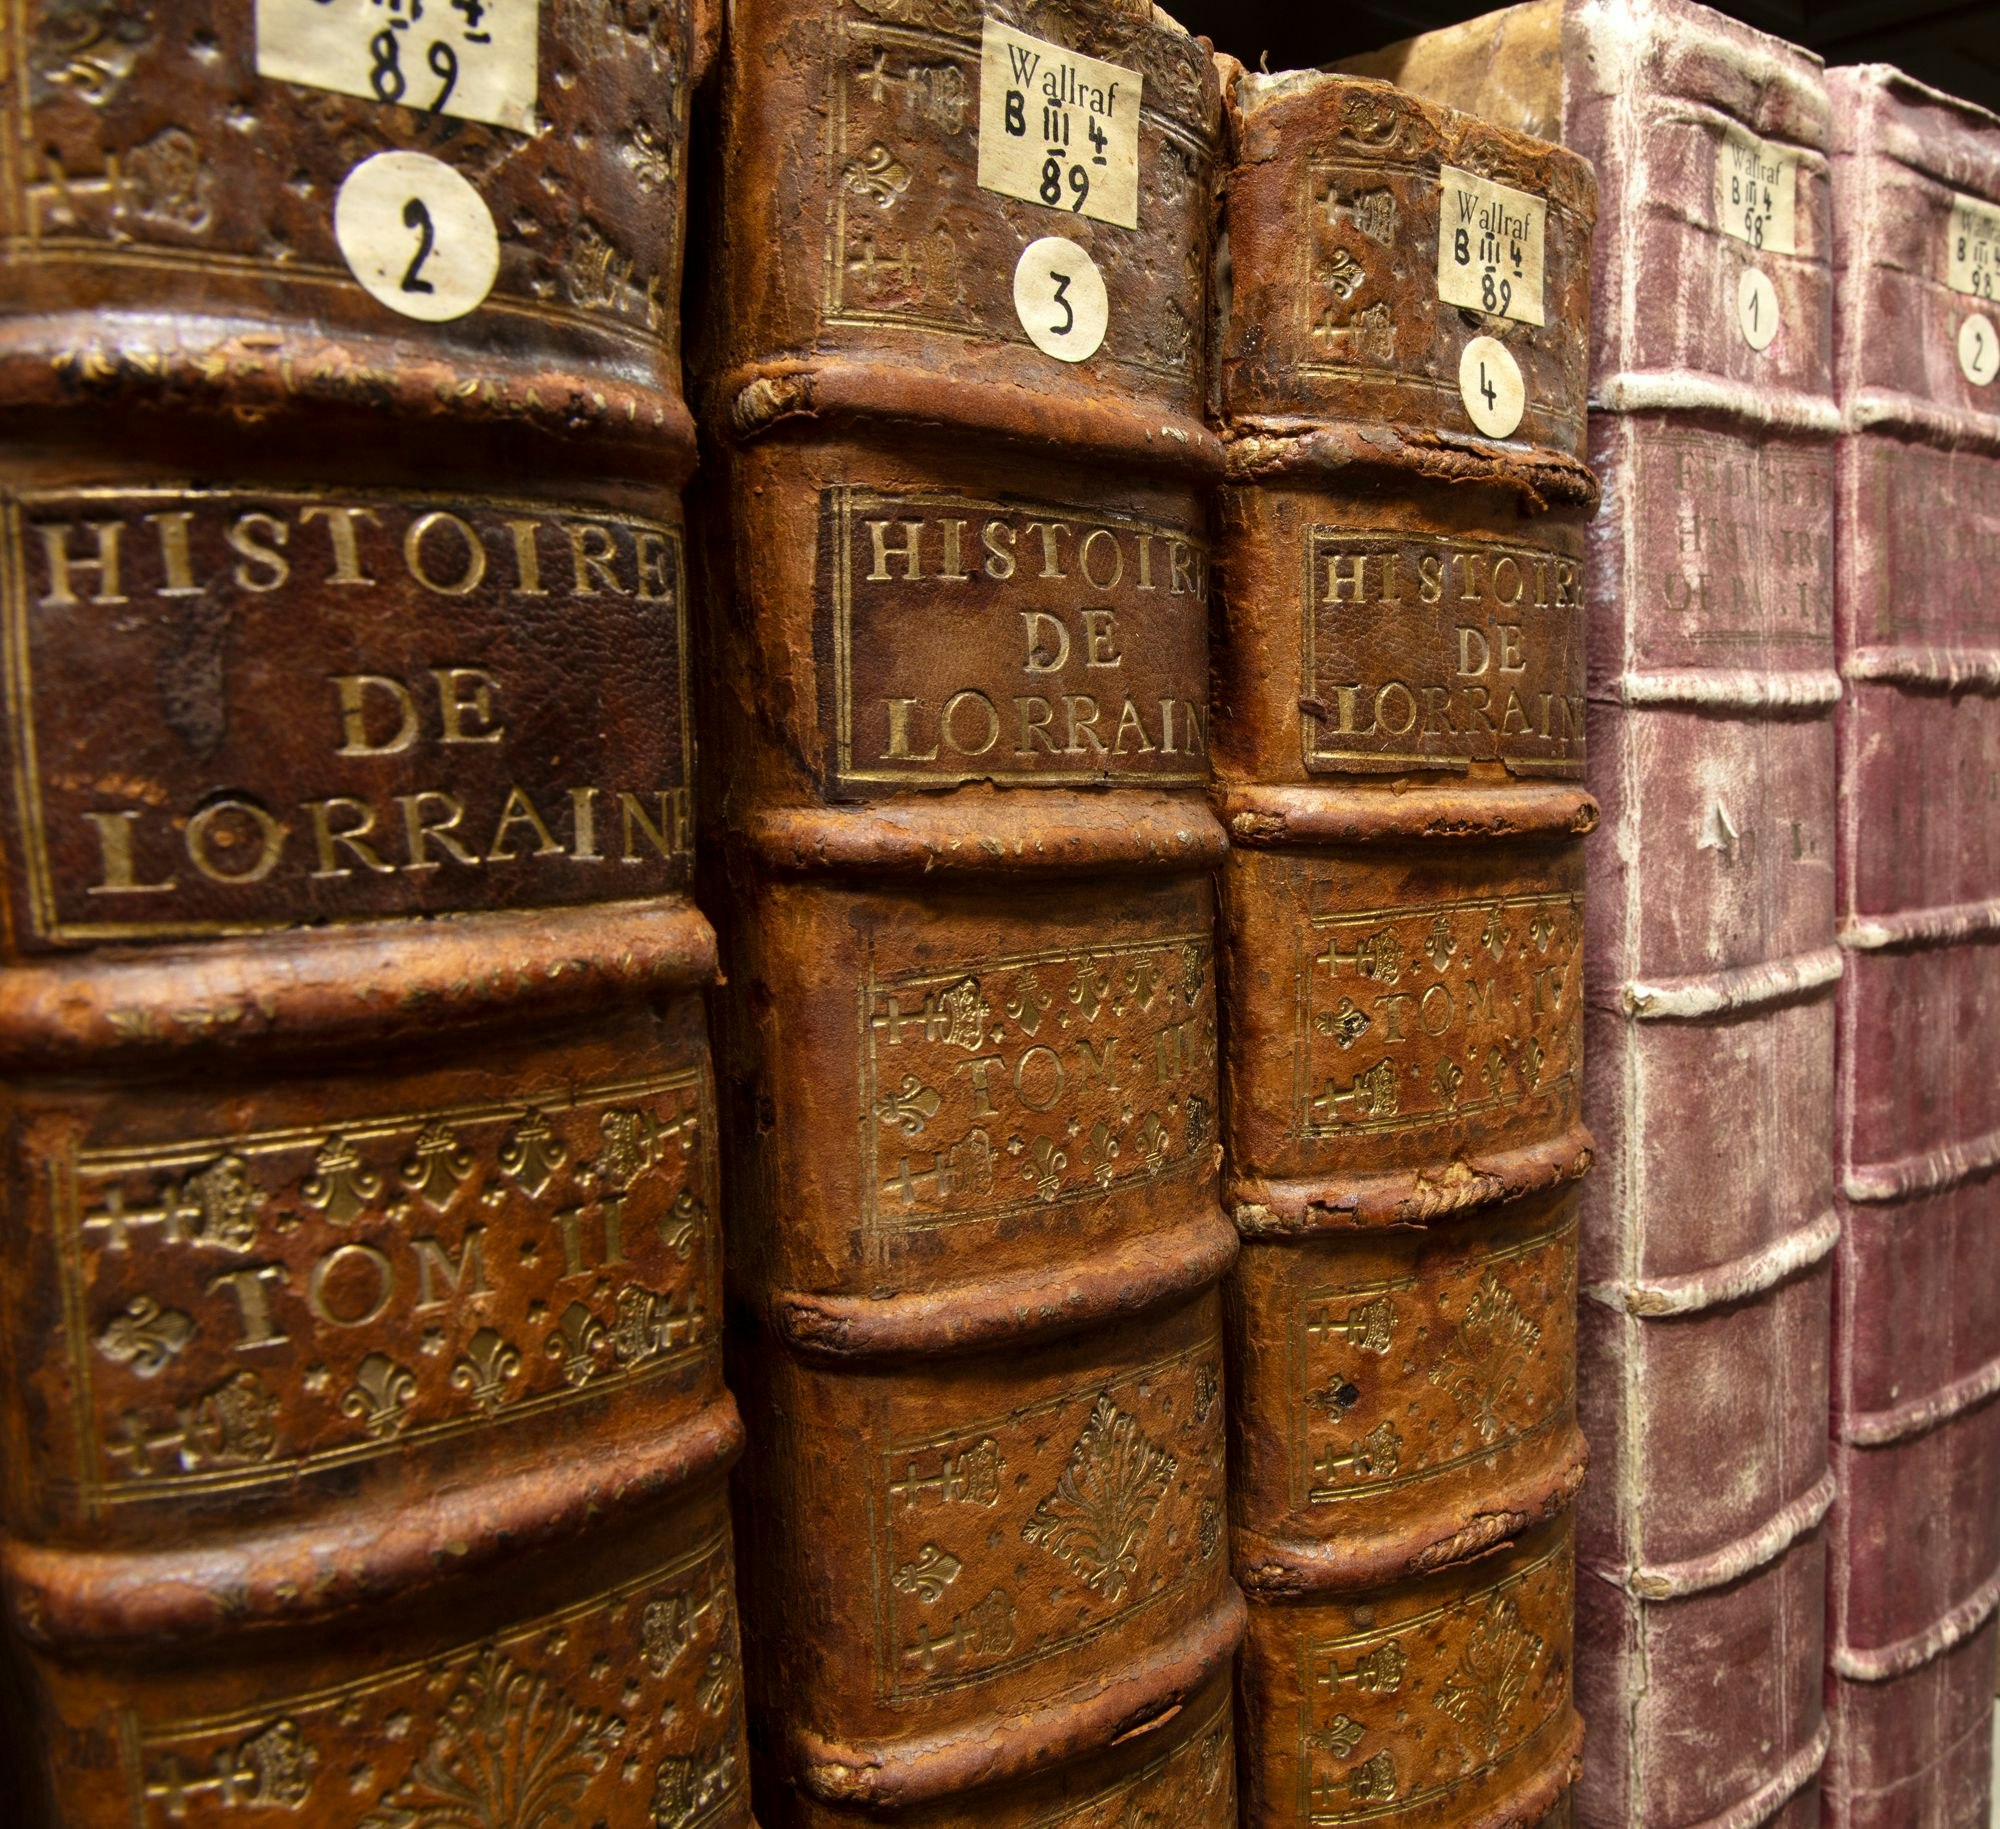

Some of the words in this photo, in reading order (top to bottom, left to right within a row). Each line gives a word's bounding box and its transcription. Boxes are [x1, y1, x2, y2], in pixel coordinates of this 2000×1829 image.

[369, 28, 458, 114] 89
[1007, 42, 1119, 119] Wallraf
[1004, 90, 1026, 137] B
[1089, 116, 1109, 156] 4
[1039, 158, 1090, 214] 89
[1731, 143, 1784, 186] Wallraf
[1457, 190, 1532, 242] Wallraf
[1732, 175, 1741, 206] B
[1763, 186, 1773, 213] 4
[400, 196, 435, 295] 2
[1454, 228, 1471, 266] B
[1509, 240, 1523, 268] 4
[1744, 211, 1764, 249] 98
[1048, 270, 1074, 336] 3
[1481, 273, 1512, 318] 89
[1749, 288, 1759, 333] 1
[1972, 270, 1993, 299] 98
[1973, 332, 1983, 373] 2
[1479, 361, 1497, 412] 4
[32, 507, 674, 605] HISTOIRE
[1020, 606, 1123, 674] DE
[1455, 624, 1527, 677] DE
[327, 667, 505, 758] DE
[1373, 977, 1499, 1043] TOM
[953, 1036, 1121, 1117] TOM
[1153, 1018, 1199, 1083] III
[206, 1225, 496, 1351] TOM
[550, 1197, 629, 1282] II
